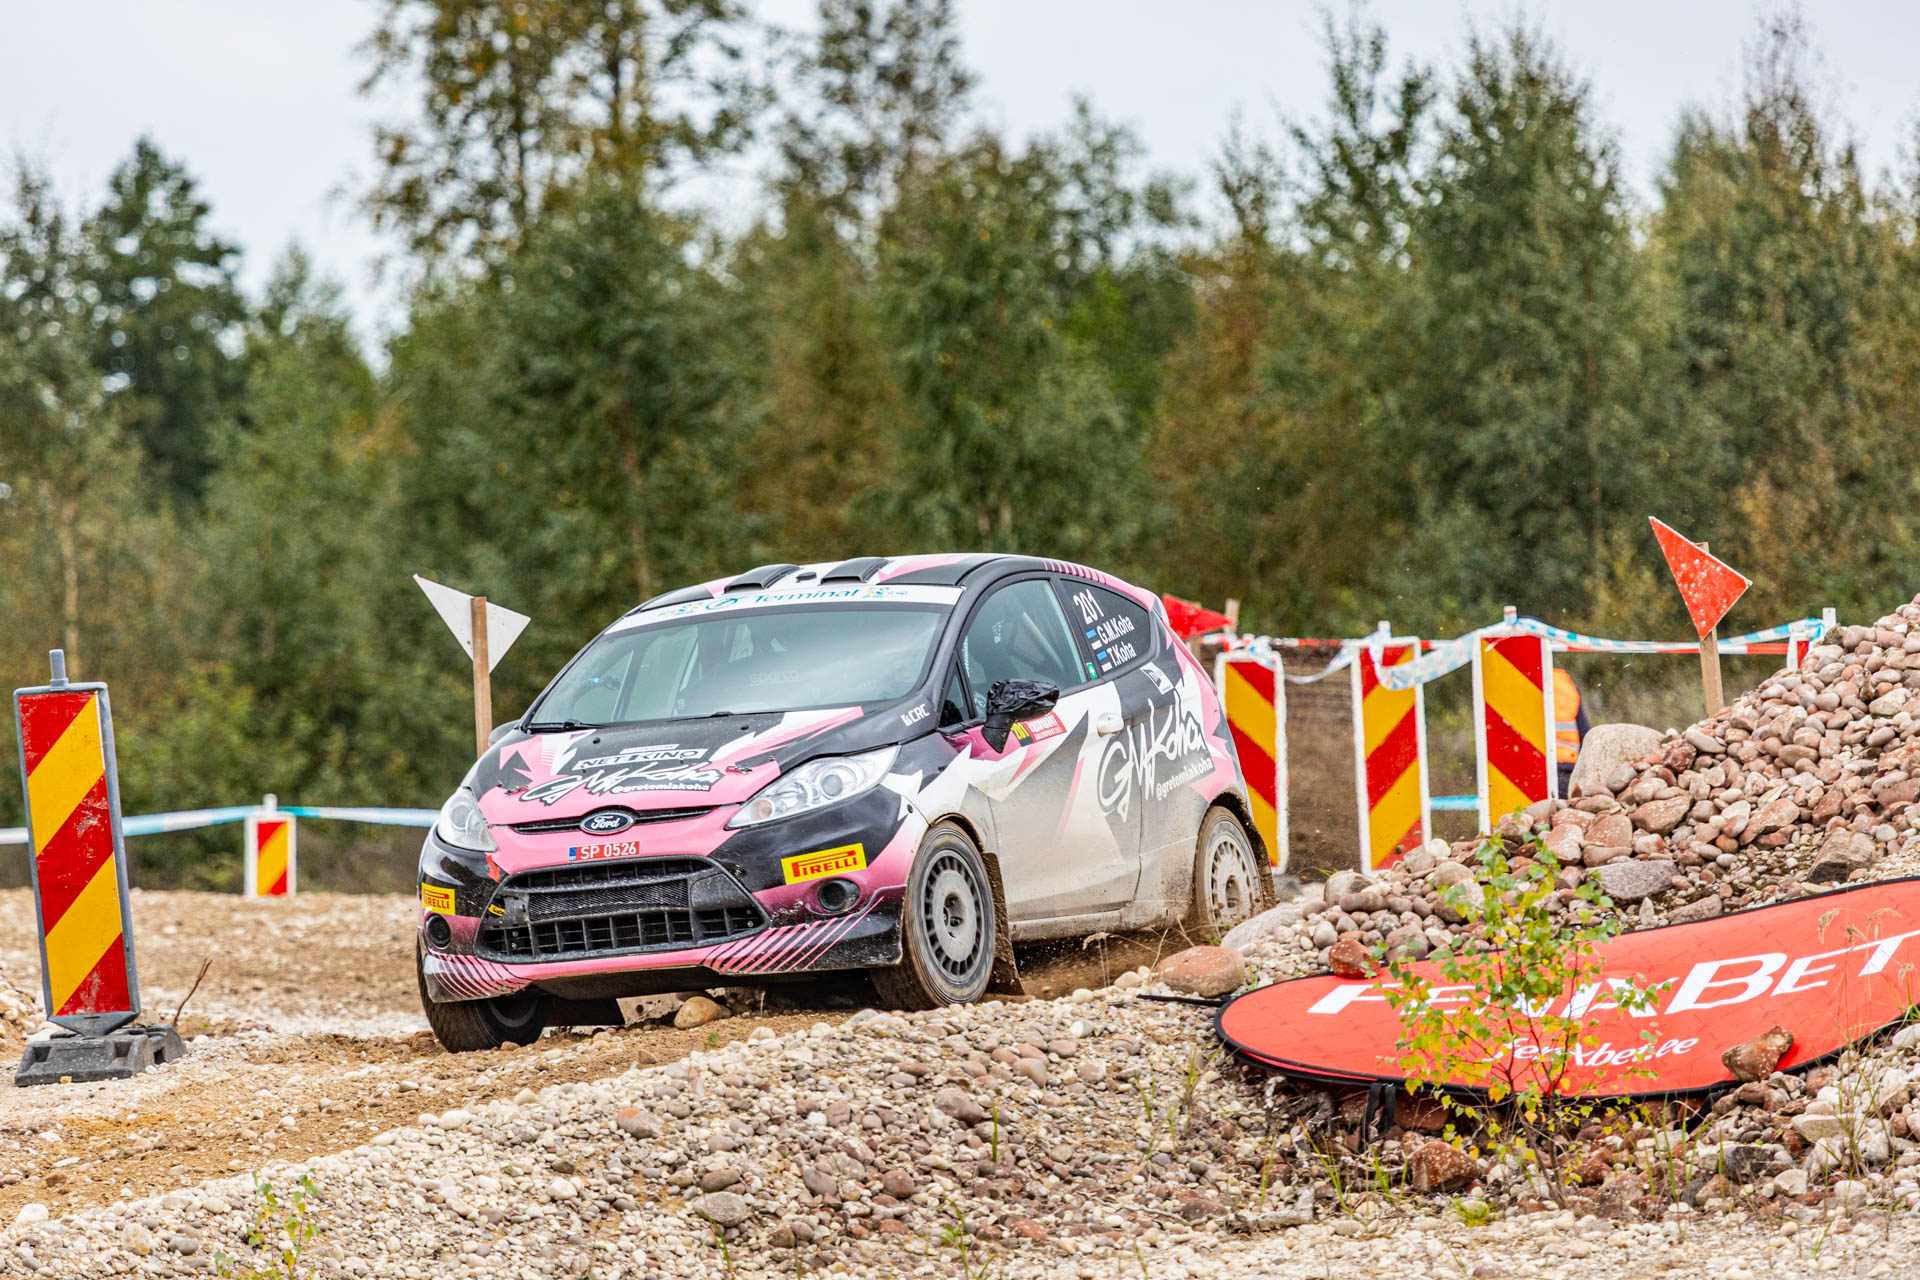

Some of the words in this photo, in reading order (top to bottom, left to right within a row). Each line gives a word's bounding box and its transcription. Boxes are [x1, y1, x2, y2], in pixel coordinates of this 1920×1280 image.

[755, 588, 860, 603] Terminal
[1073, 588, 1104, 625] 201
[1096, 614, 1135, 645] G.M.Koha
[1106, 641, 1137, 667] T.Koha
[908, 703, 930, 723] CRC
[581, 755, 625, 767] NET
[642, 750, 699, 760] KINO
[611, 782, 712, 795] @gretemiakoha
[1156, 756, 1214, 801] @gretemiakoha
[590, 815, 621, 829] Ford
[580, 846, 600, 859] SP
[603, 842, 637, 857] 0526
[791, 850, 858, 878] PIRELLI
[423, 888, 450, 910] PIRELLI
[1482, 1037, 1700, 1067] fenxbet.ee
